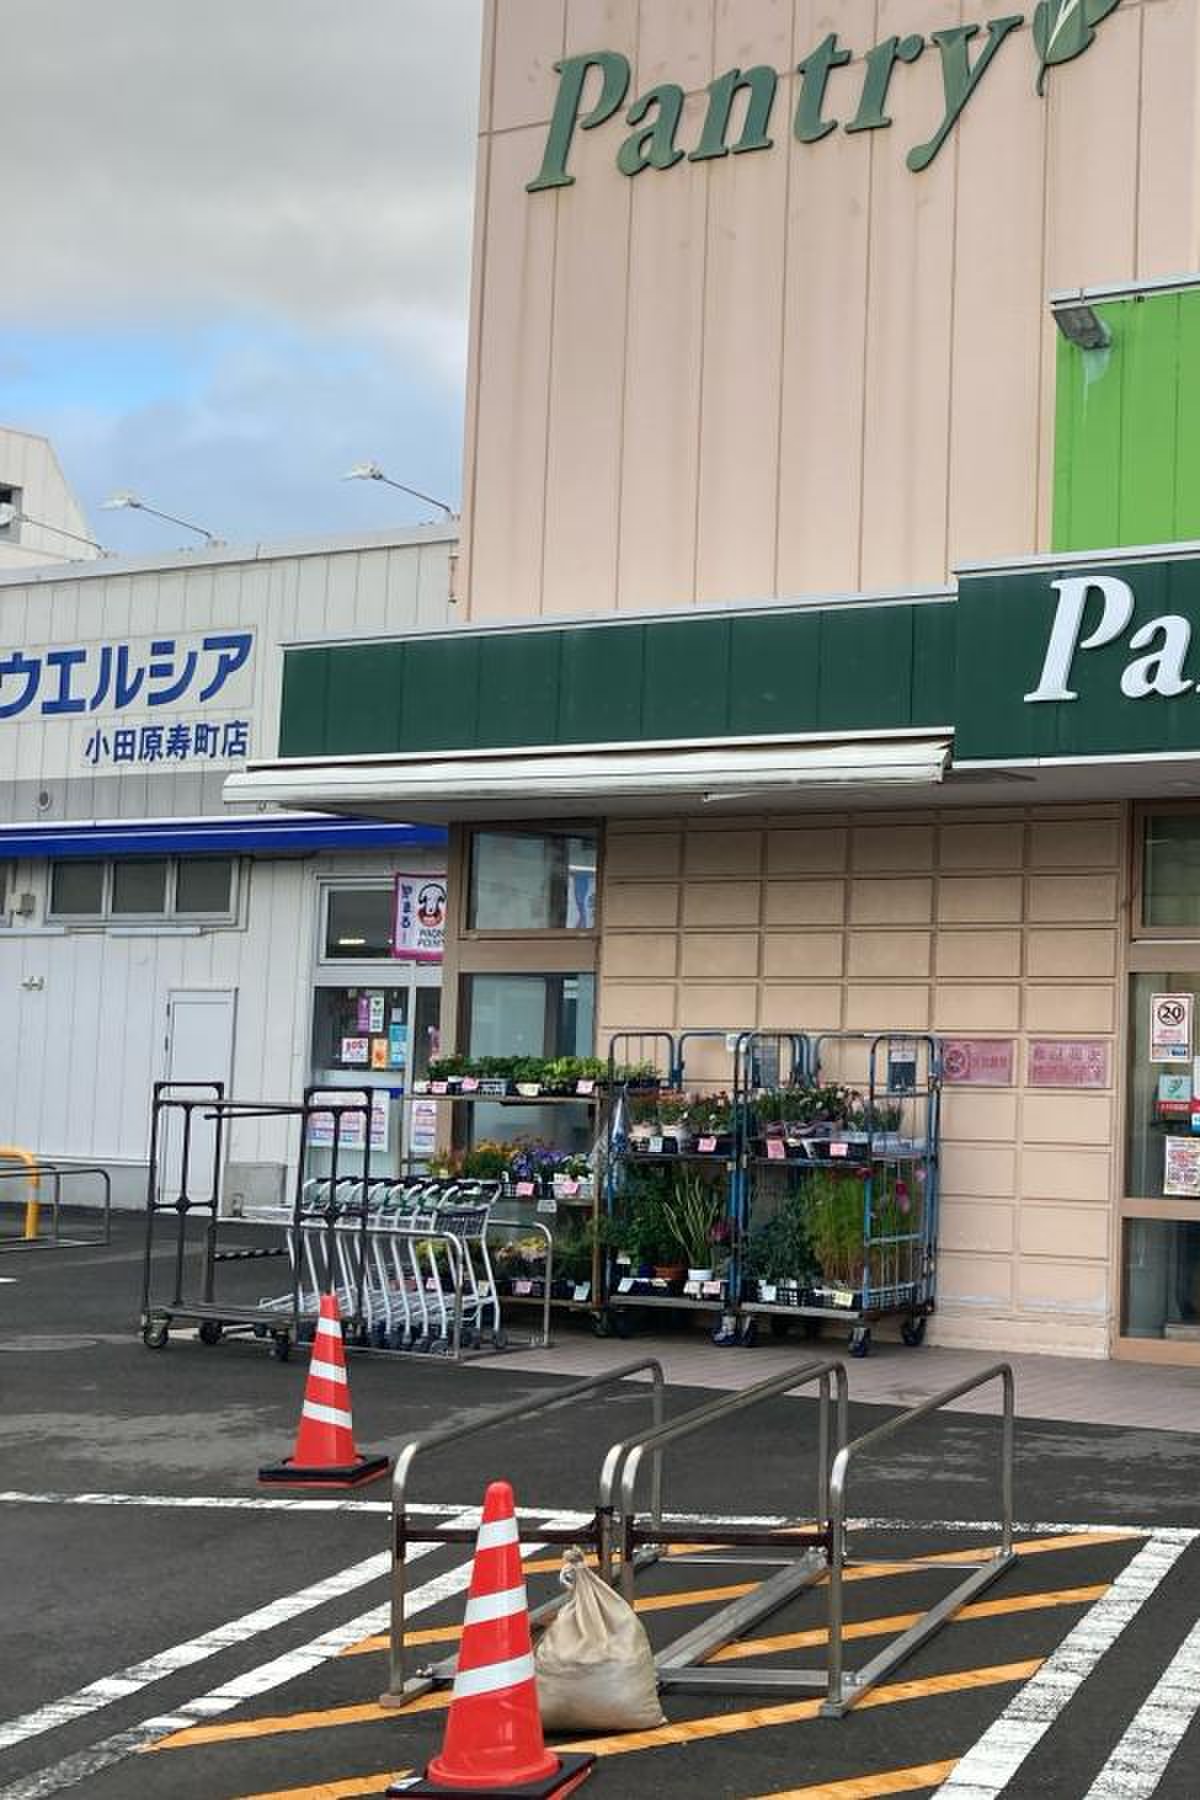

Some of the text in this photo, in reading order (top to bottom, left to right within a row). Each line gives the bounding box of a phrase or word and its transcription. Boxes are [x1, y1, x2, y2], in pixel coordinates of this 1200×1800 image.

[526, 15, 1024, 192] Pantry
[0, 633, 254, 720] ウエルシア
[85, 719, 249, 764] 小田原寿町店
[1161, 1006, 1182, 1019] 20
